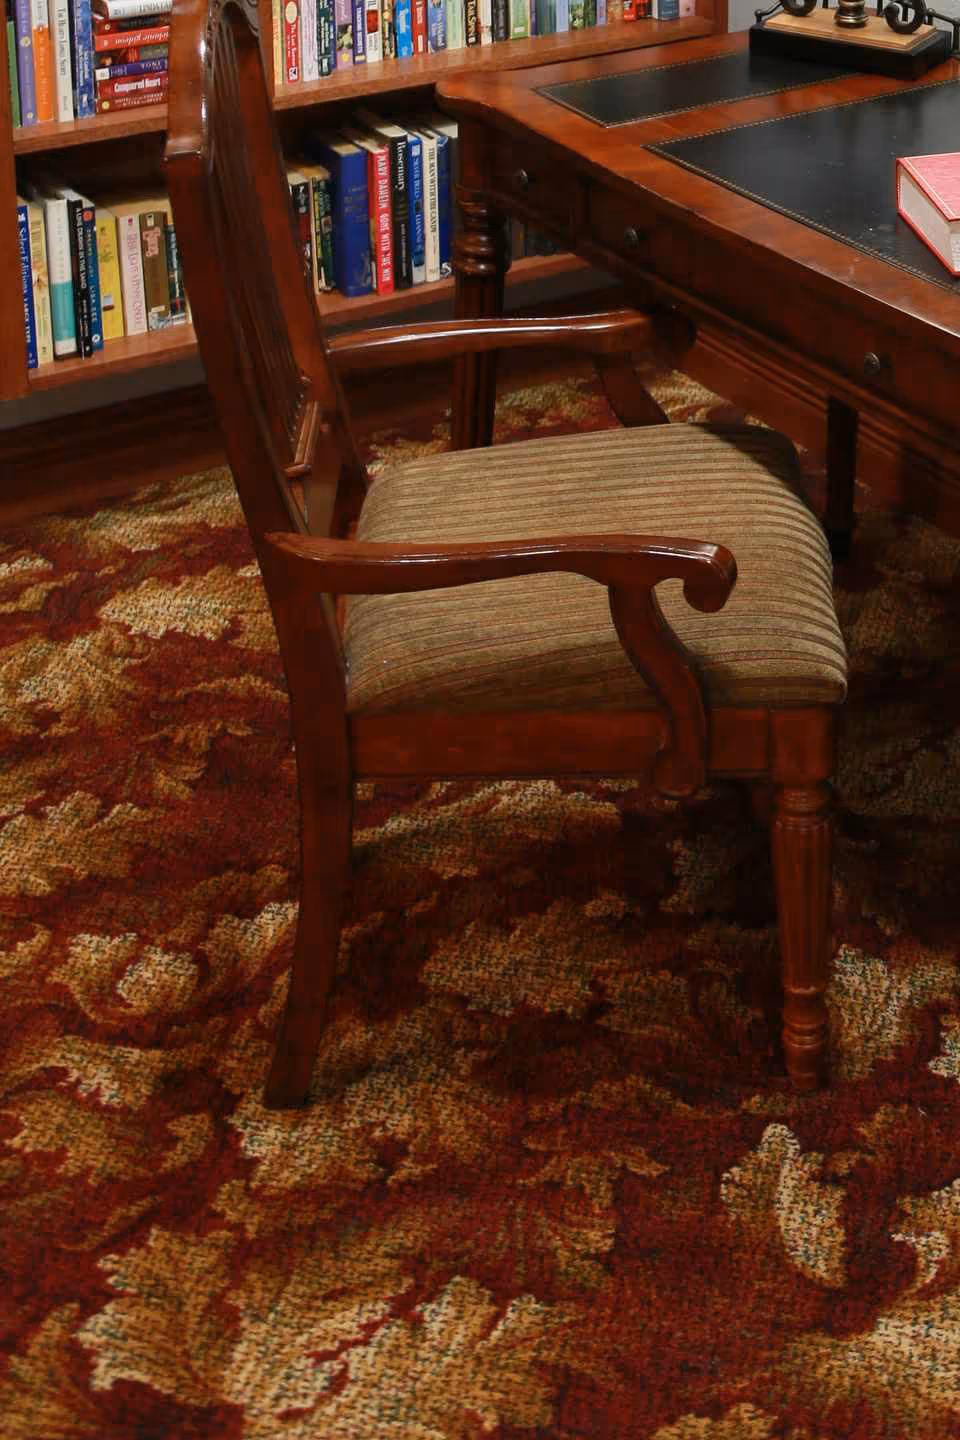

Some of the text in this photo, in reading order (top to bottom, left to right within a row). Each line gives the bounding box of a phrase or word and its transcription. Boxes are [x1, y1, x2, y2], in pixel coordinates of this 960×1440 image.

[428, 148, 436, 160] THE
[395, 141, 406, 191] Rosemary
[378, 156, 388, 208] MARY DAHEIM
[379, 214, 388, 232] GONE
[380, 234, 390, 252] WITH
[19, 227, 28, 294] Select Editions
[79, 250, 86, 258] IN
[381, 254, 390, 266] THE
[80, 272, 88, 289] SAND
[24, 326, 32, 343] TYPE
